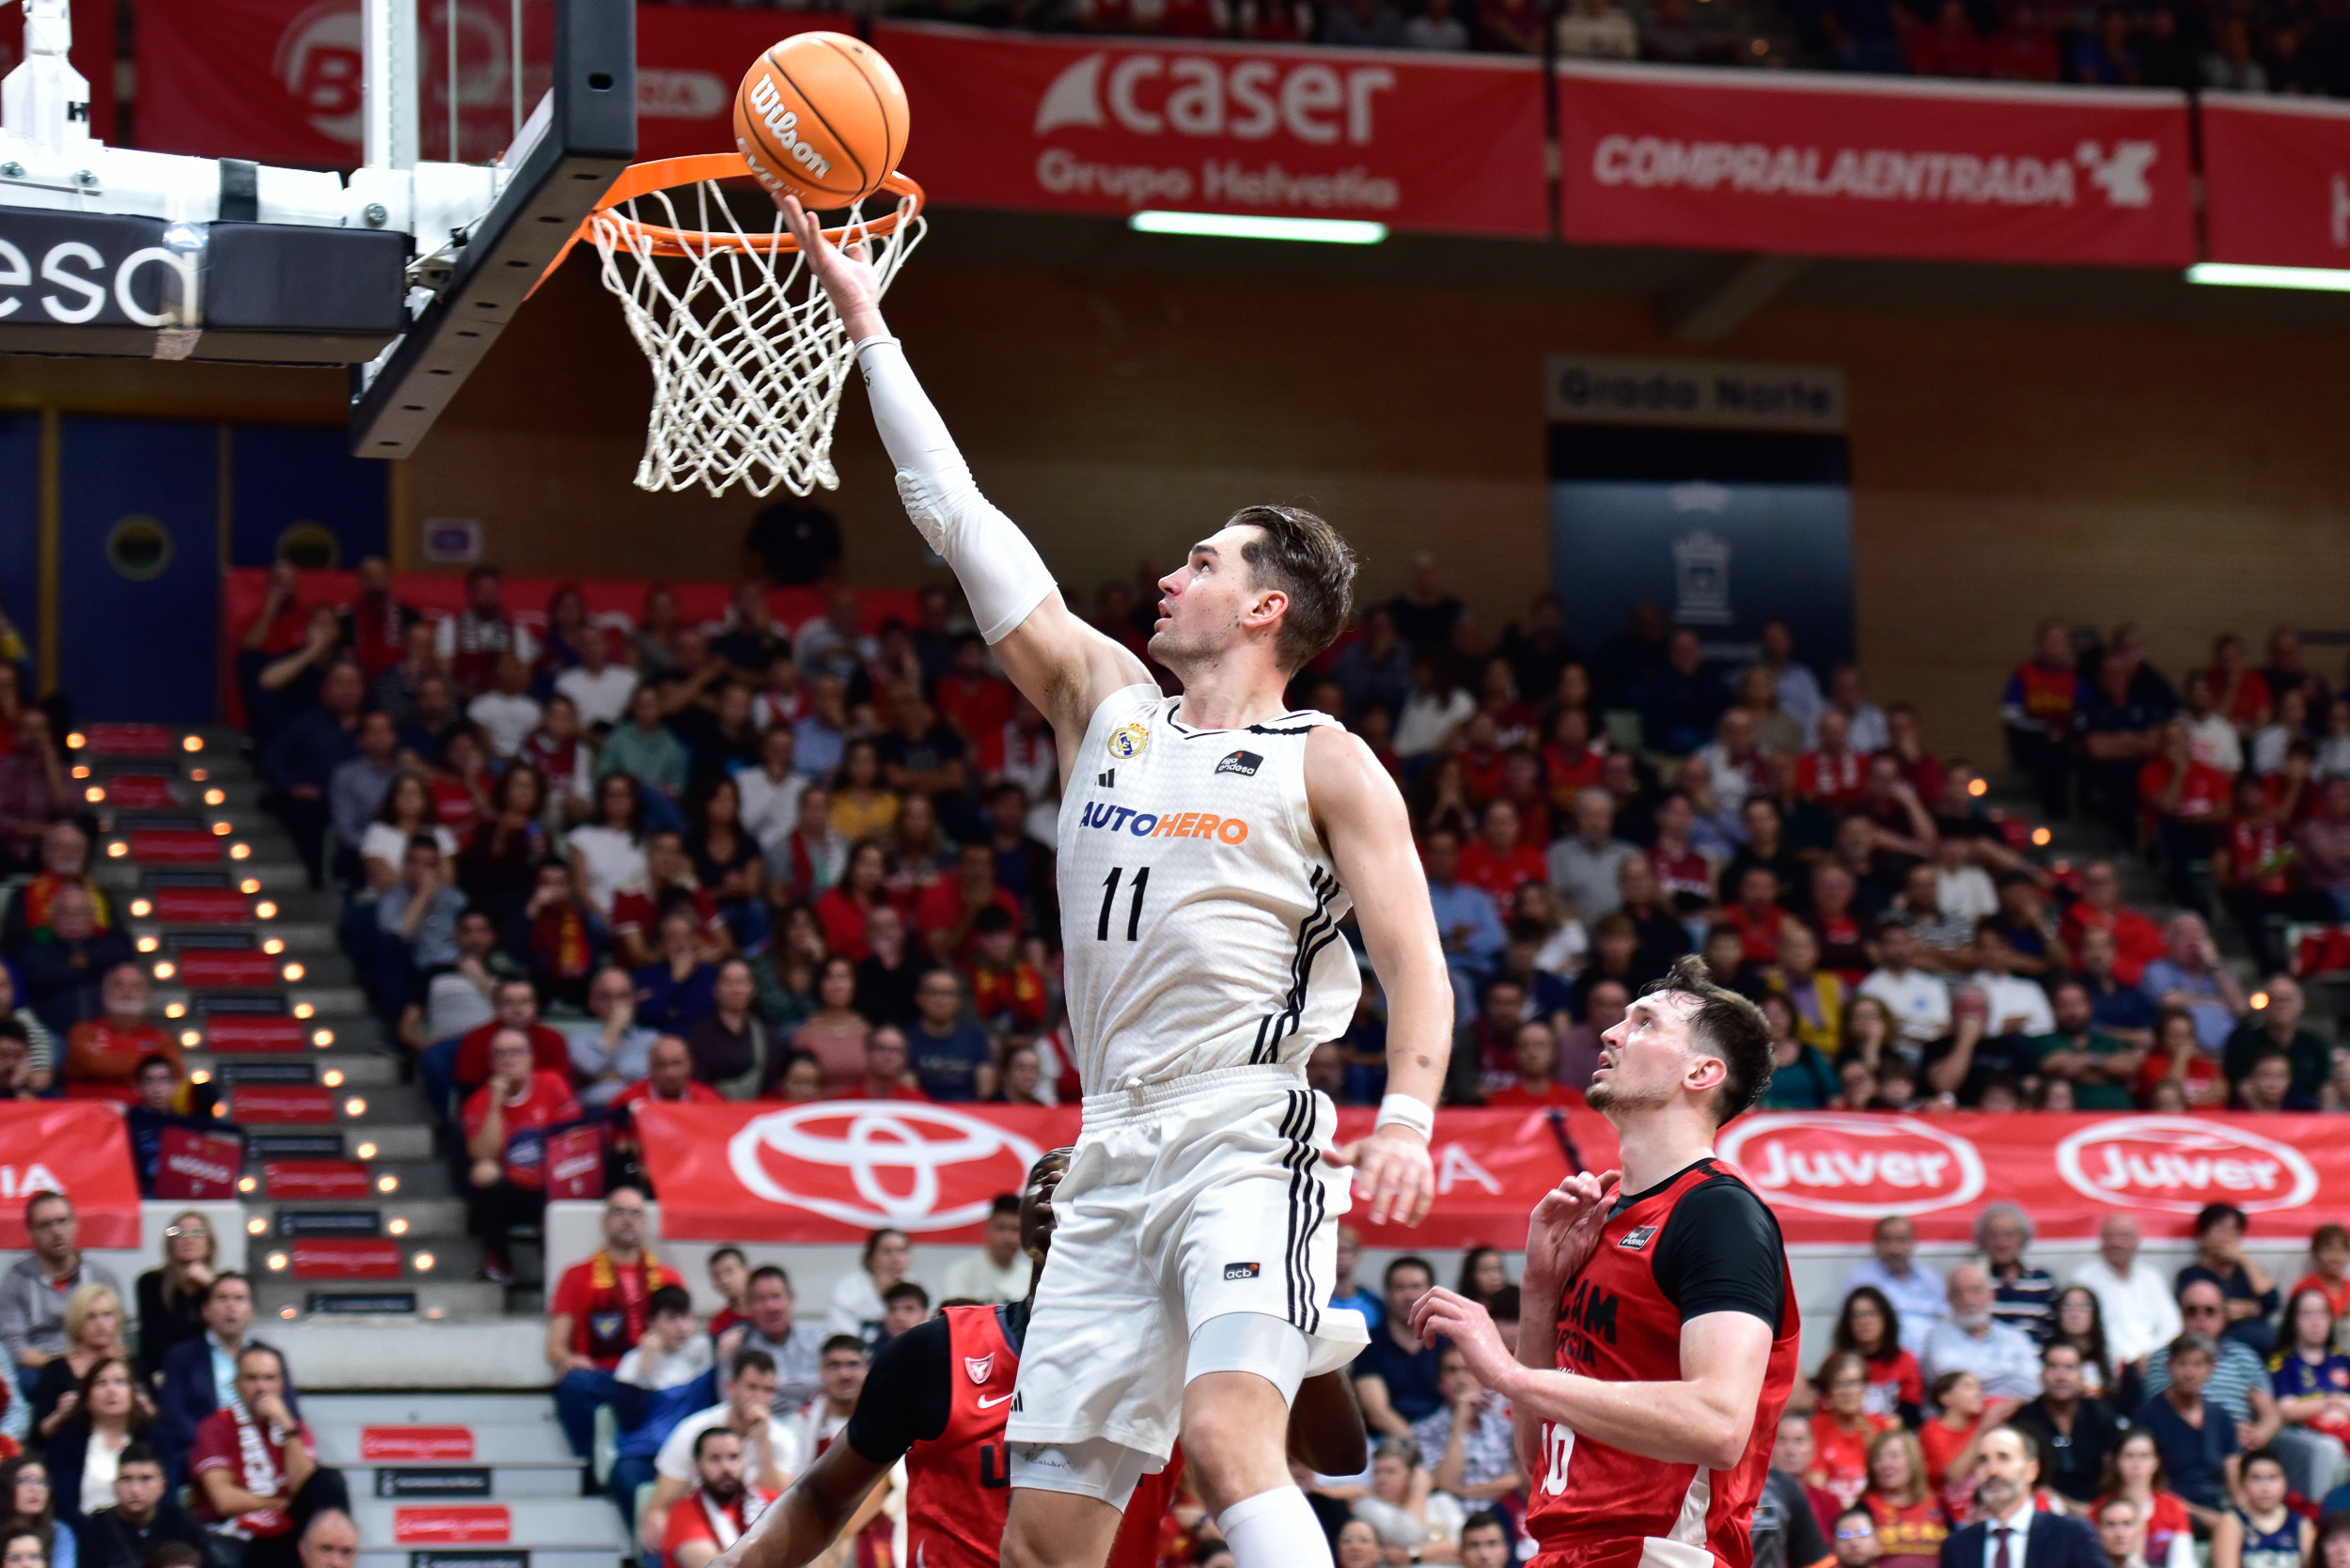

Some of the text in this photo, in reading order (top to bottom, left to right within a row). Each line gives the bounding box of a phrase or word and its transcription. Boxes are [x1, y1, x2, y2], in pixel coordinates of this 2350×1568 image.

[750, 72, 833, 180] Wilson
[1107, 55, 1397, 145] caser
[1036, 148, 1401, 210] Grupo Helvetia
[1594, 133, 2075, 206] COMPRALAENTRADA
[1217, 763, 1256, 776] endesa
[1079, 801, 1248, 845] AUTOHERO
[1096, 866, 1151, 942] 11
[1754, 1140, 1951, 1190] Juver
[2093, 1144, 2283, 1192] Juver
[1226, 1267, 1252, 1279] acb
[1559, 1275, 1619, 1347] CAM
[1557, 1328, 1597, 1368] RCIA
